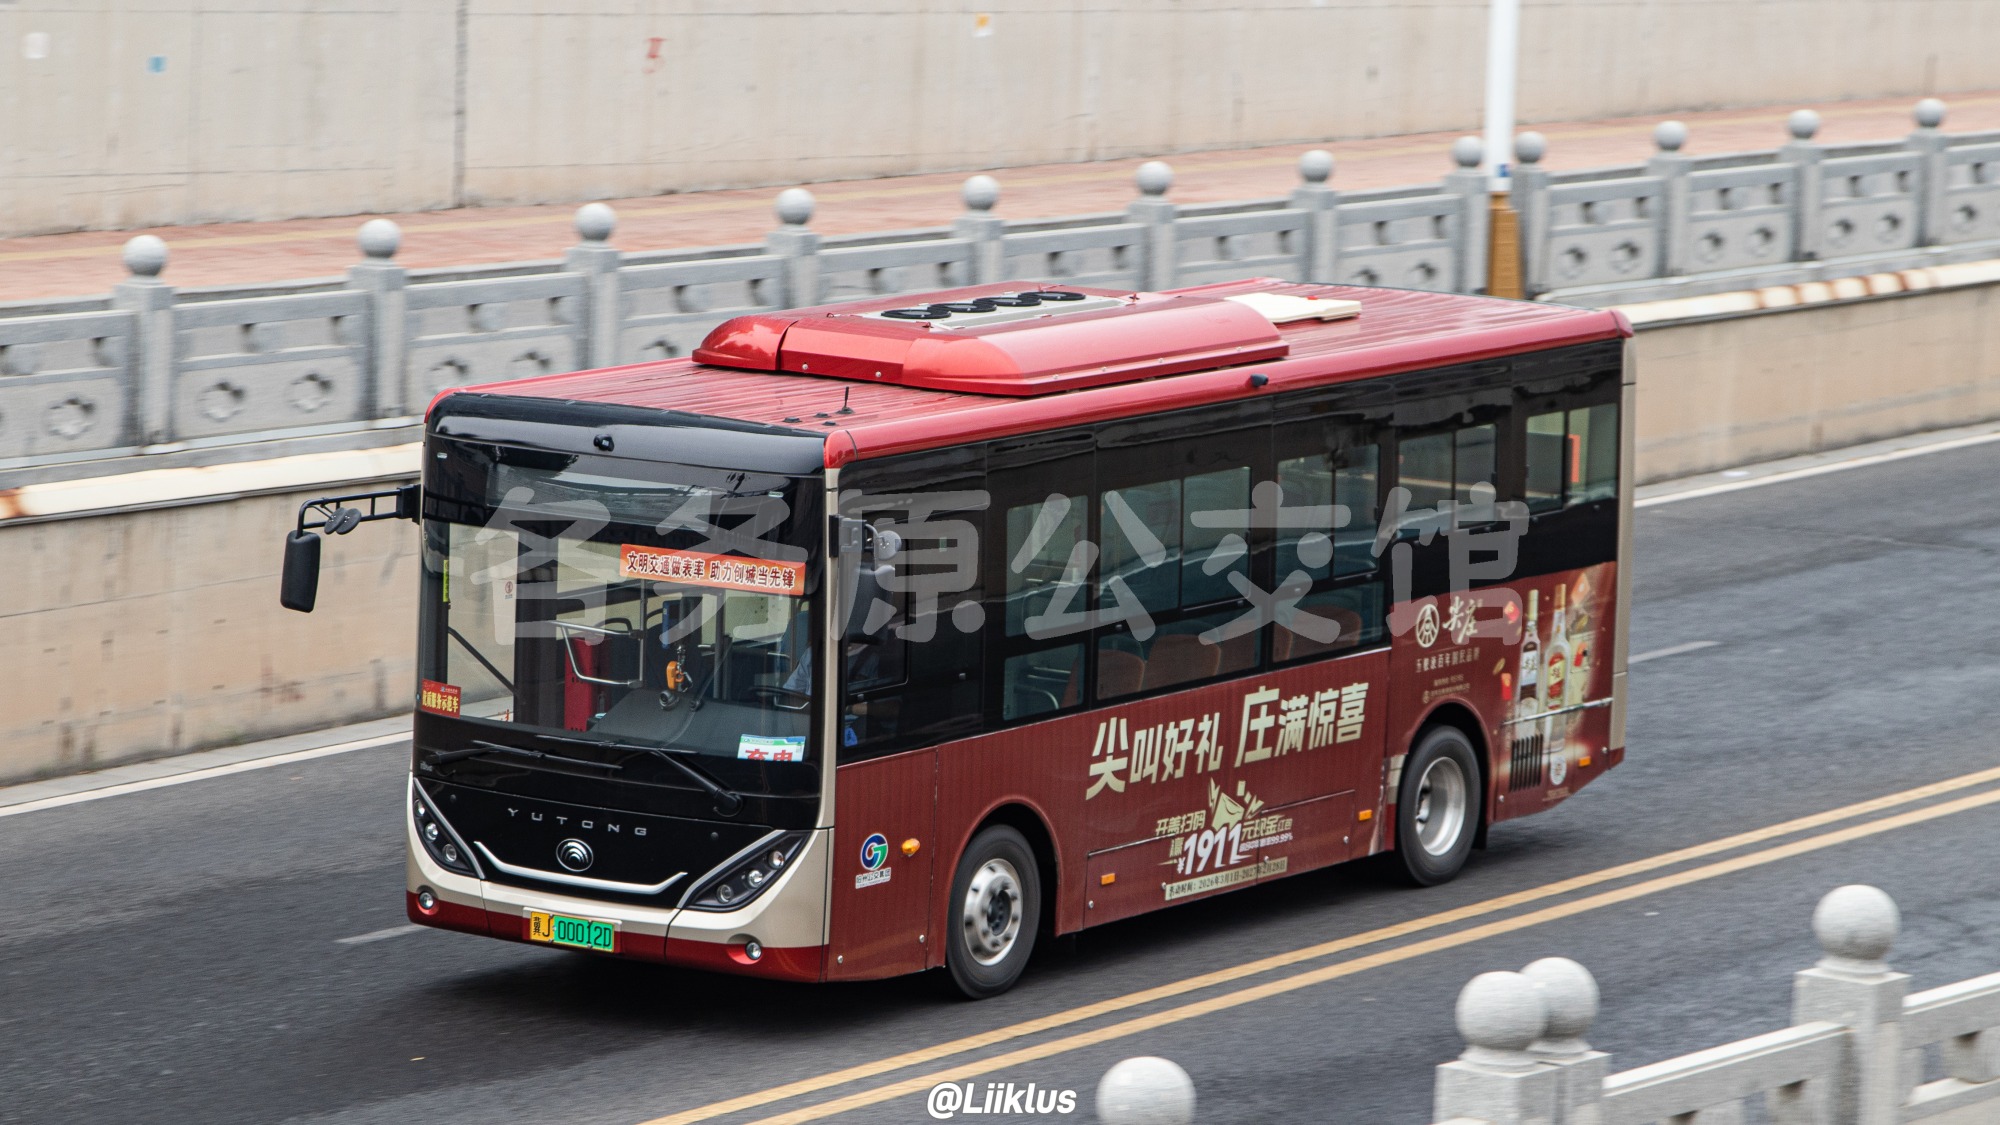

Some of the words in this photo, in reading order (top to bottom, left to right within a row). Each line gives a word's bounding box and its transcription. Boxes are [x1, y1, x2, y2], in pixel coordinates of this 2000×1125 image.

[627, 551, 705, 578] 文明交通做表率
[710, 561, 796, 588] 助力创城当先锋
[1086, 712, 1223, 800] 尖叫好礼
[1234, 682, 1369, 768] 庄满惊喜
[507, 808, 647, 836] YUTONG
[1156, 810, 1206, 836] 开盖扫码
